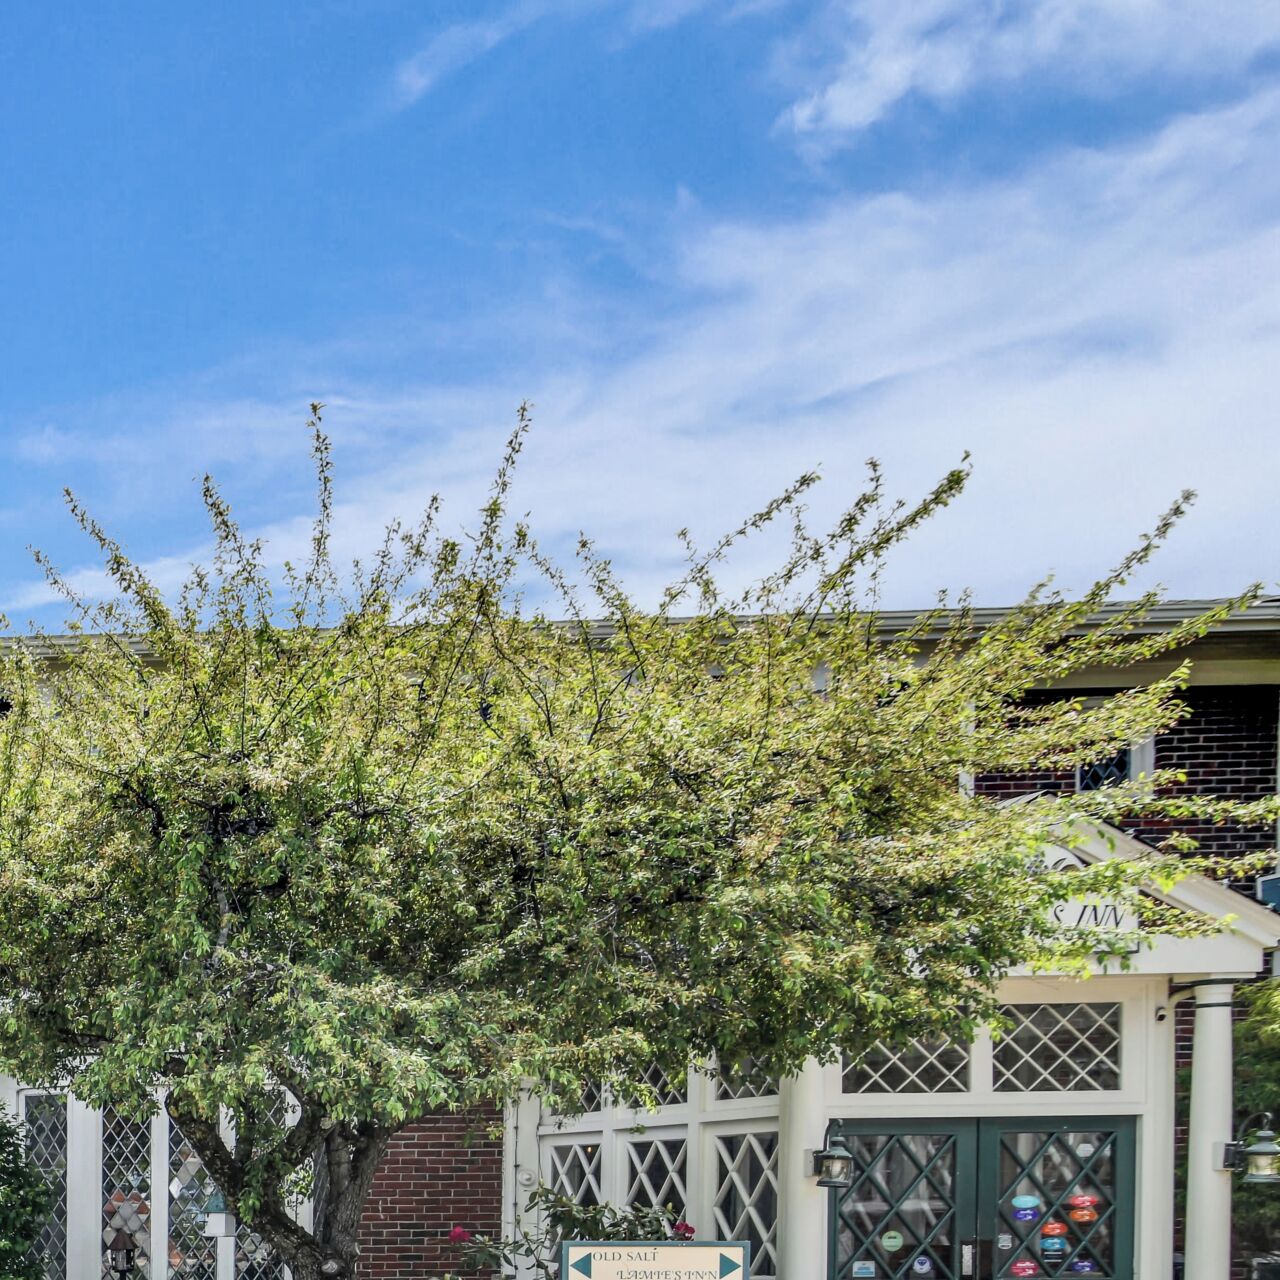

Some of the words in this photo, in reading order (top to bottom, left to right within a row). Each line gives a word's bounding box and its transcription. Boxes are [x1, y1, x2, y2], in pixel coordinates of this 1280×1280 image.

[593, 1251, 622, 1262] OLD
[626, 1250, 659, 1262] SALT
[684, 1270, 718, 1280] INN
